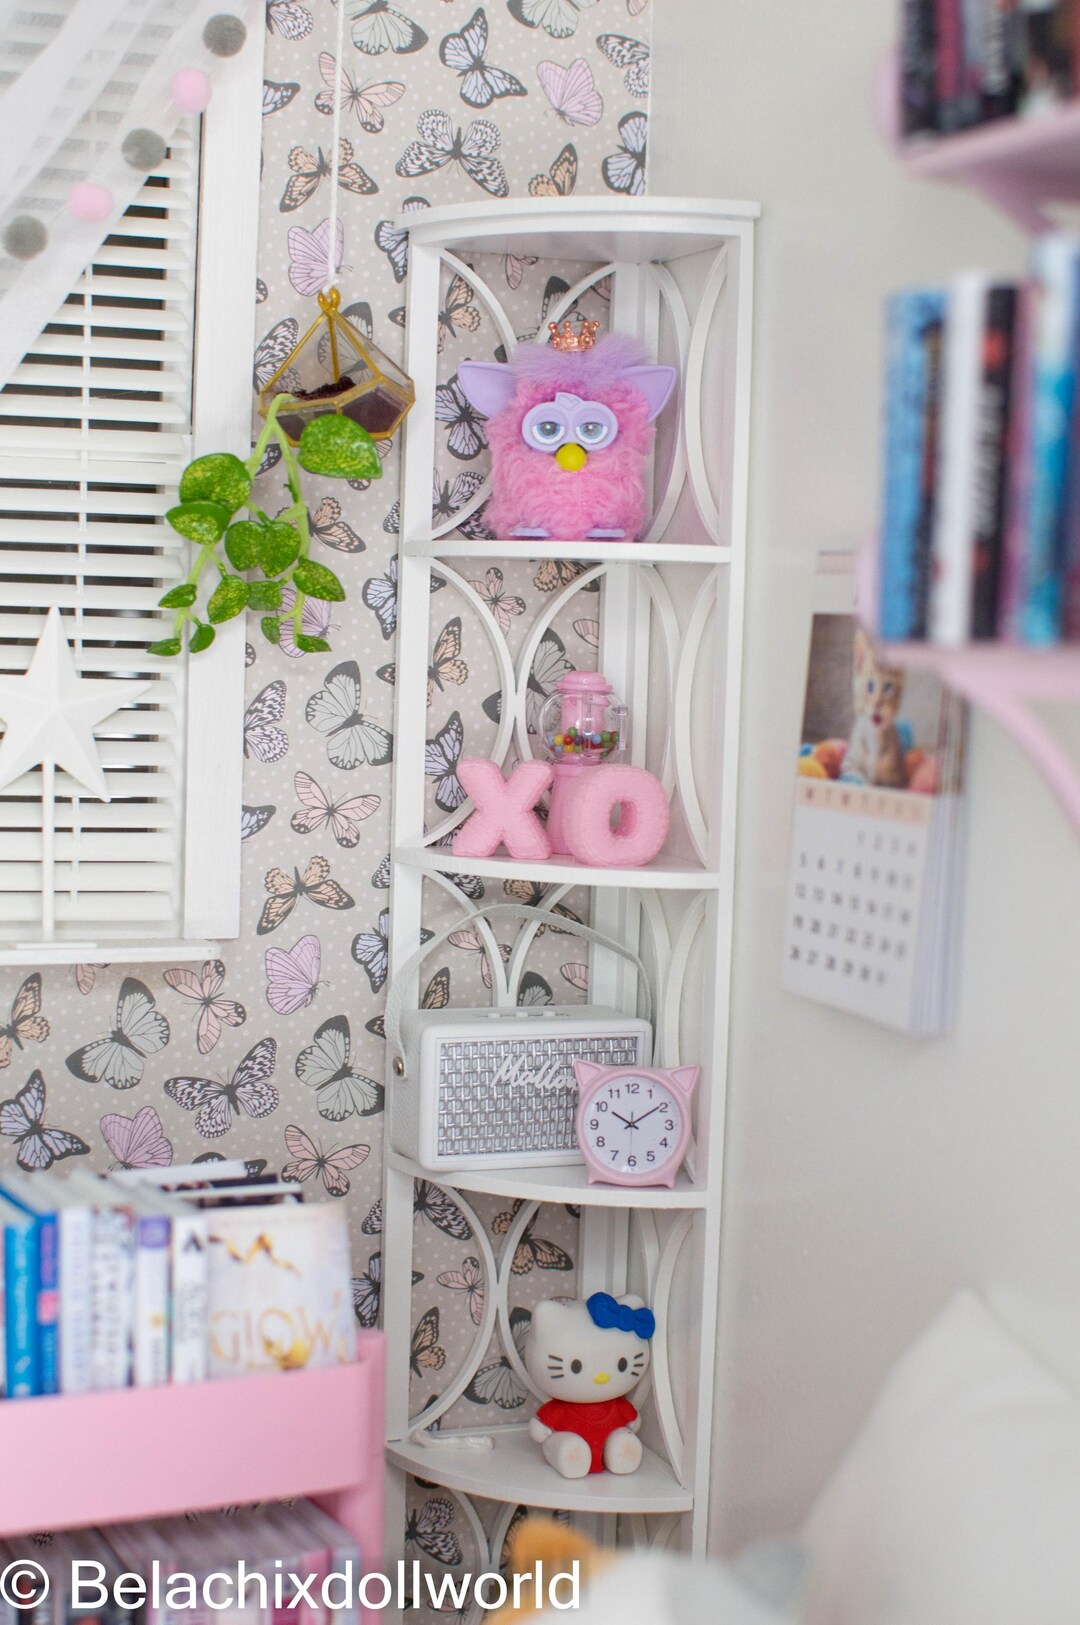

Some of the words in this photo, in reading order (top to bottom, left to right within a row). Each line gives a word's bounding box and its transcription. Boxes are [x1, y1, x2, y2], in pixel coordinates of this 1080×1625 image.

[608, 1088, 620, 1099] 11
[625, 1083, 640, 1094] 12
[647, 1089, 653, 1099] 1
[595, 1101, 608, 1112] 10
[659, 1102, 668, 1113] 2
[589, 1119, 599, 1130] 9
[664, 1119, 674, 1131] 3
[596, 1136, 605, 1147] 8
[659, 1137, 668, 1148] 4
[610, 1150, 619, 1161] 7
[627, 1155, 637, 1167] 6
[646, 1151, 655, 1162] 5
